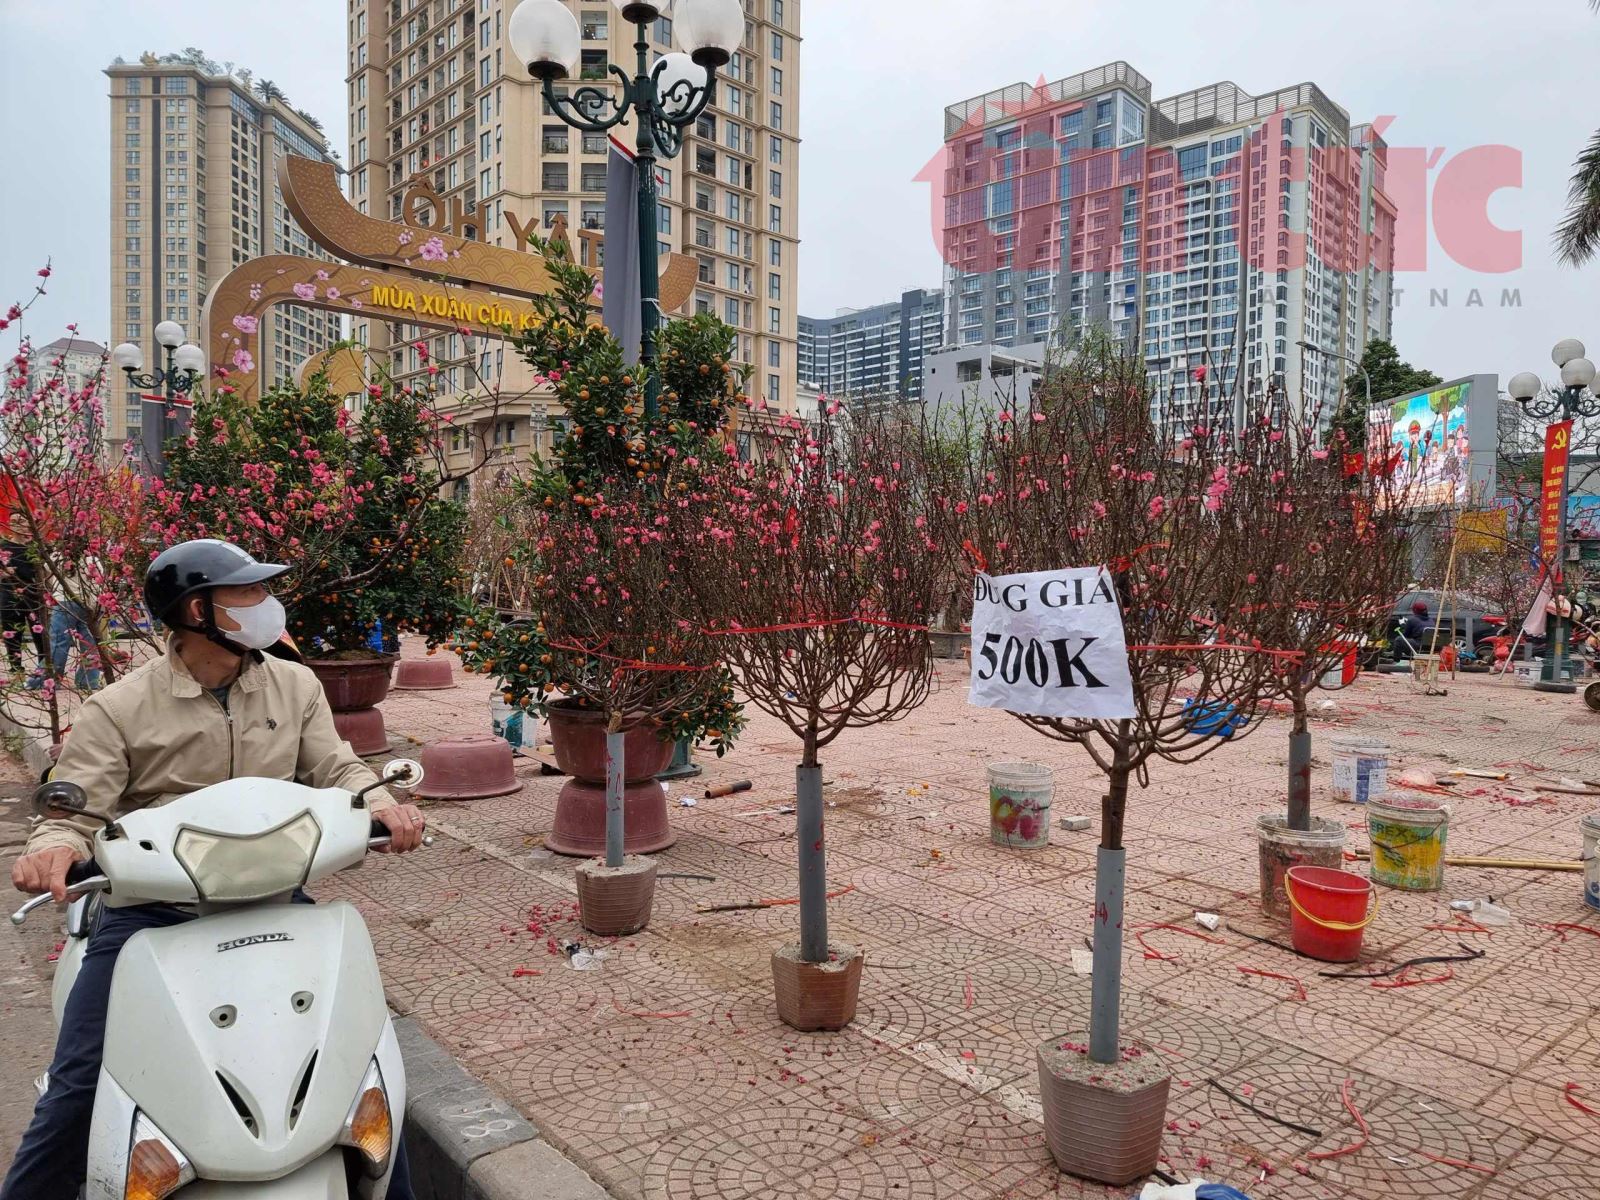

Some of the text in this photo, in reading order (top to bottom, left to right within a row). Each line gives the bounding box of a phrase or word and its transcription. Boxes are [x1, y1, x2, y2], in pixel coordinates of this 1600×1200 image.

[372, 279, 417, 312] MÙA
[420, 294, 473, 321] XUÂN
[477, 301, 515, 330] CỦA
[978, 632, 1109, 688] 500K
[217, 932, 295, 953] HONDA
